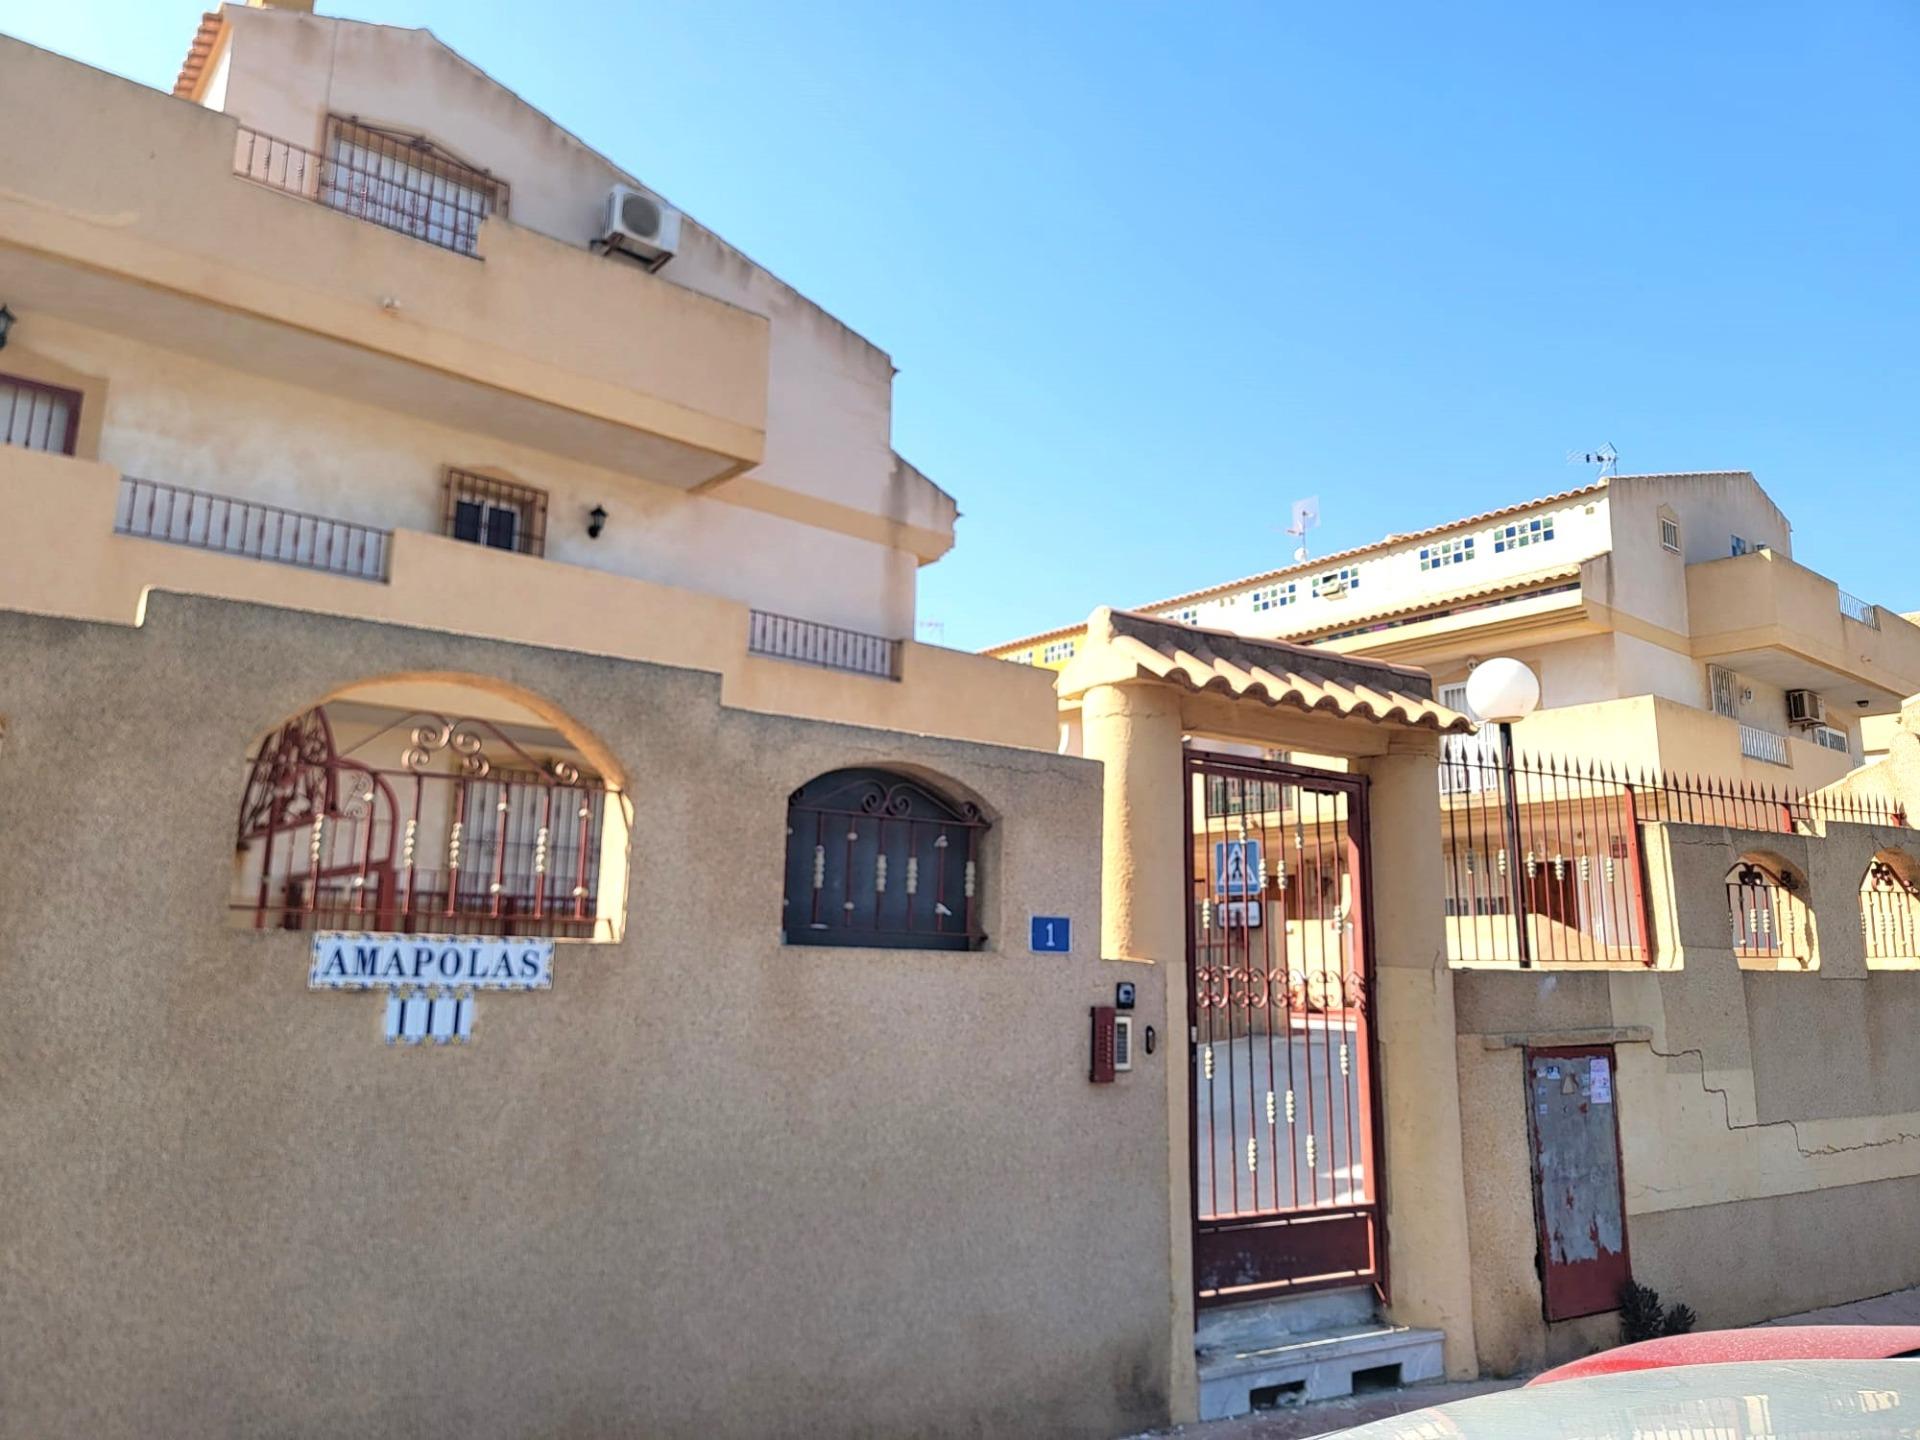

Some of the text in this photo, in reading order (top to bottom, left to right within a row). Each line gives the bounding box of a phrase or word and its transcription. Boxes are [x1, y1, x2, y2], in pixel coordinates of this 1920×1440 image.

[1045, 922, 1056, 947] 1
[322, 945, 541, 978] AMAPOLAS
[397, 998, 462, 1035] III
